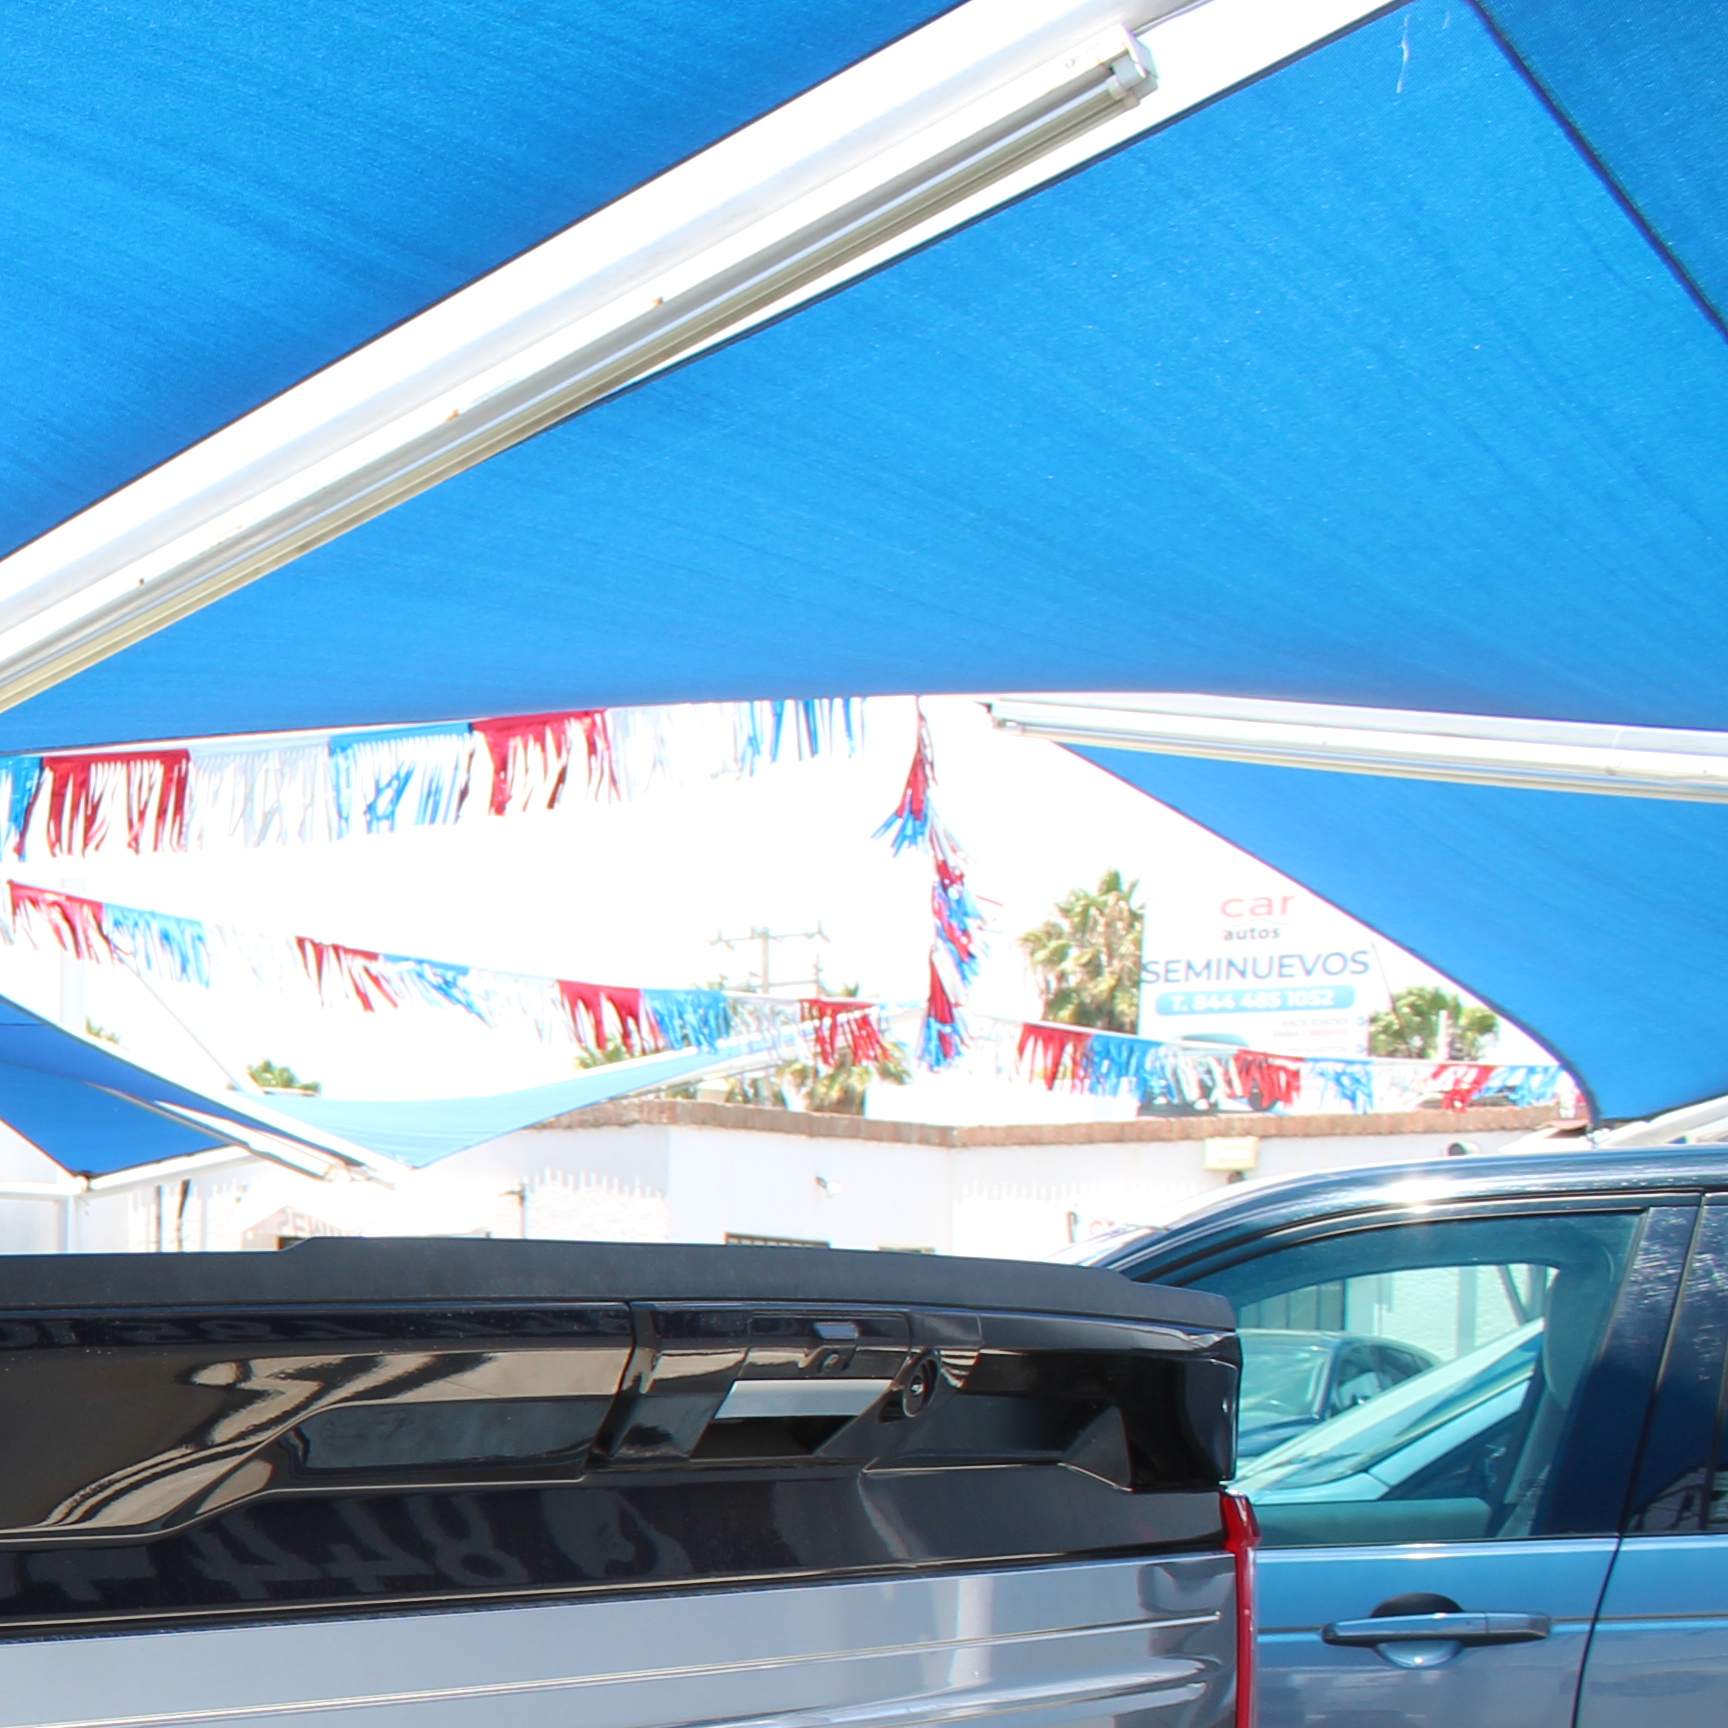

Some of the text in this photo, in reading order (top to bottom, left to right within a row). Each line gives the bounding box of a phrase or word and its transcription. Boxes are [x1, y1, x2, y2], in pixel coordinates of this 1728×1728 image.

[1220, 894, 1296, 919] car
[1223, 926, 1281, 942] autos
[1141, 950, 1372, 984] SEMINUEVOS
